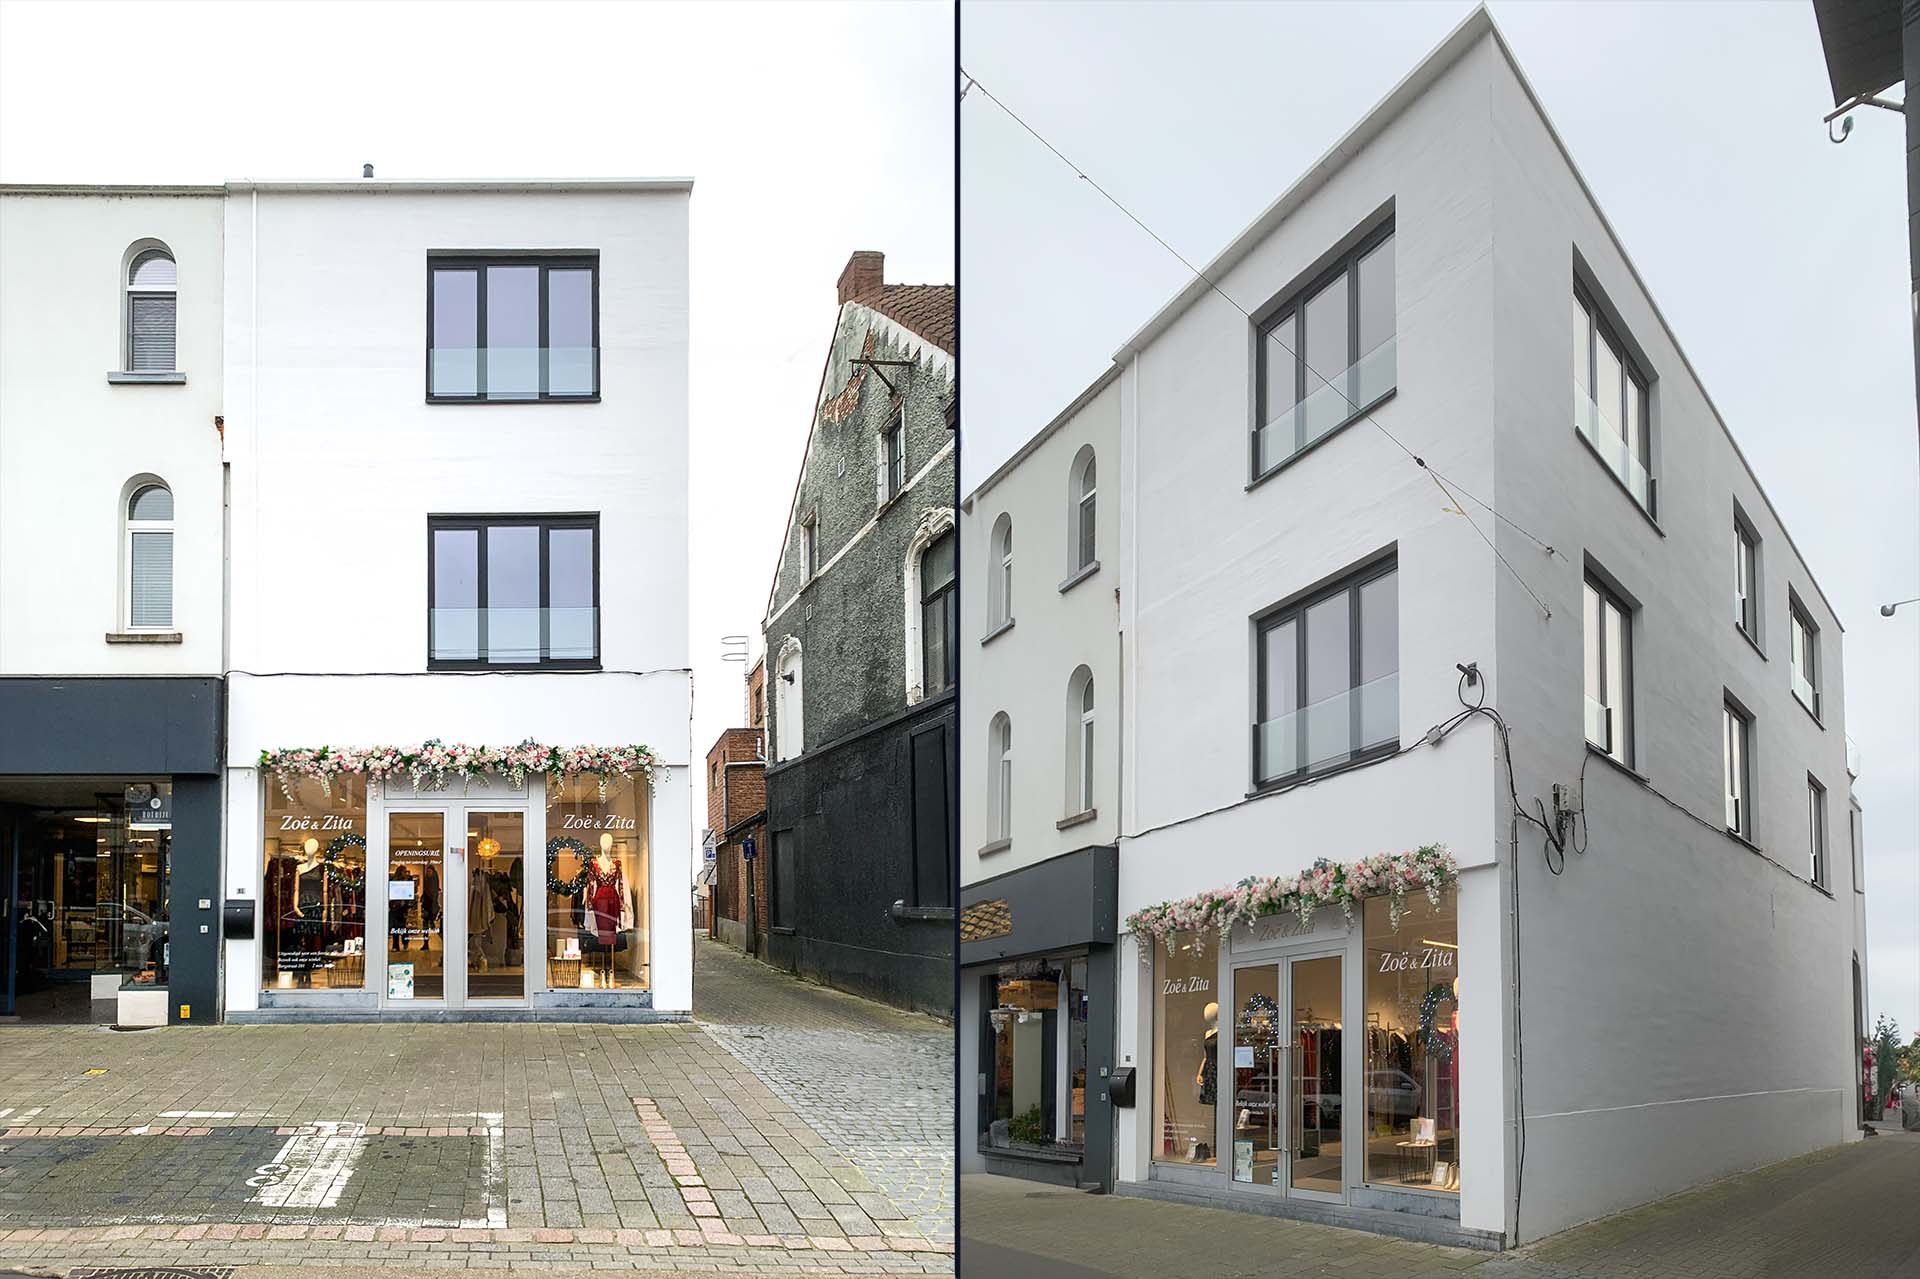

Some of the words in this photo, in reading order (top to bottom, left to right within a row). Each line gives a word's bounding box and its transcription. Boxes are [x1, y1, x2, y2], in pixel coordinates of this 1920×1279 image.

[280, 815, 311, 830] Zoë
[310, 820, 319, 830] &
[321, 815, 353, 830] Zita
[563, 814, 593, 829] Zoë
[593, 819, 602, 829] &
[604, 814, 636, 829] Zita
[1379, 951, 1409, 973] Zoë
[1409, 957, 1418, 970] &
[1420, 948, 1453, 968] Zita
[1163, 978, 1182, 994] Zoë
[1181, 983, 1187, 993] &
[1188, 975, 1210, 992] Zita
